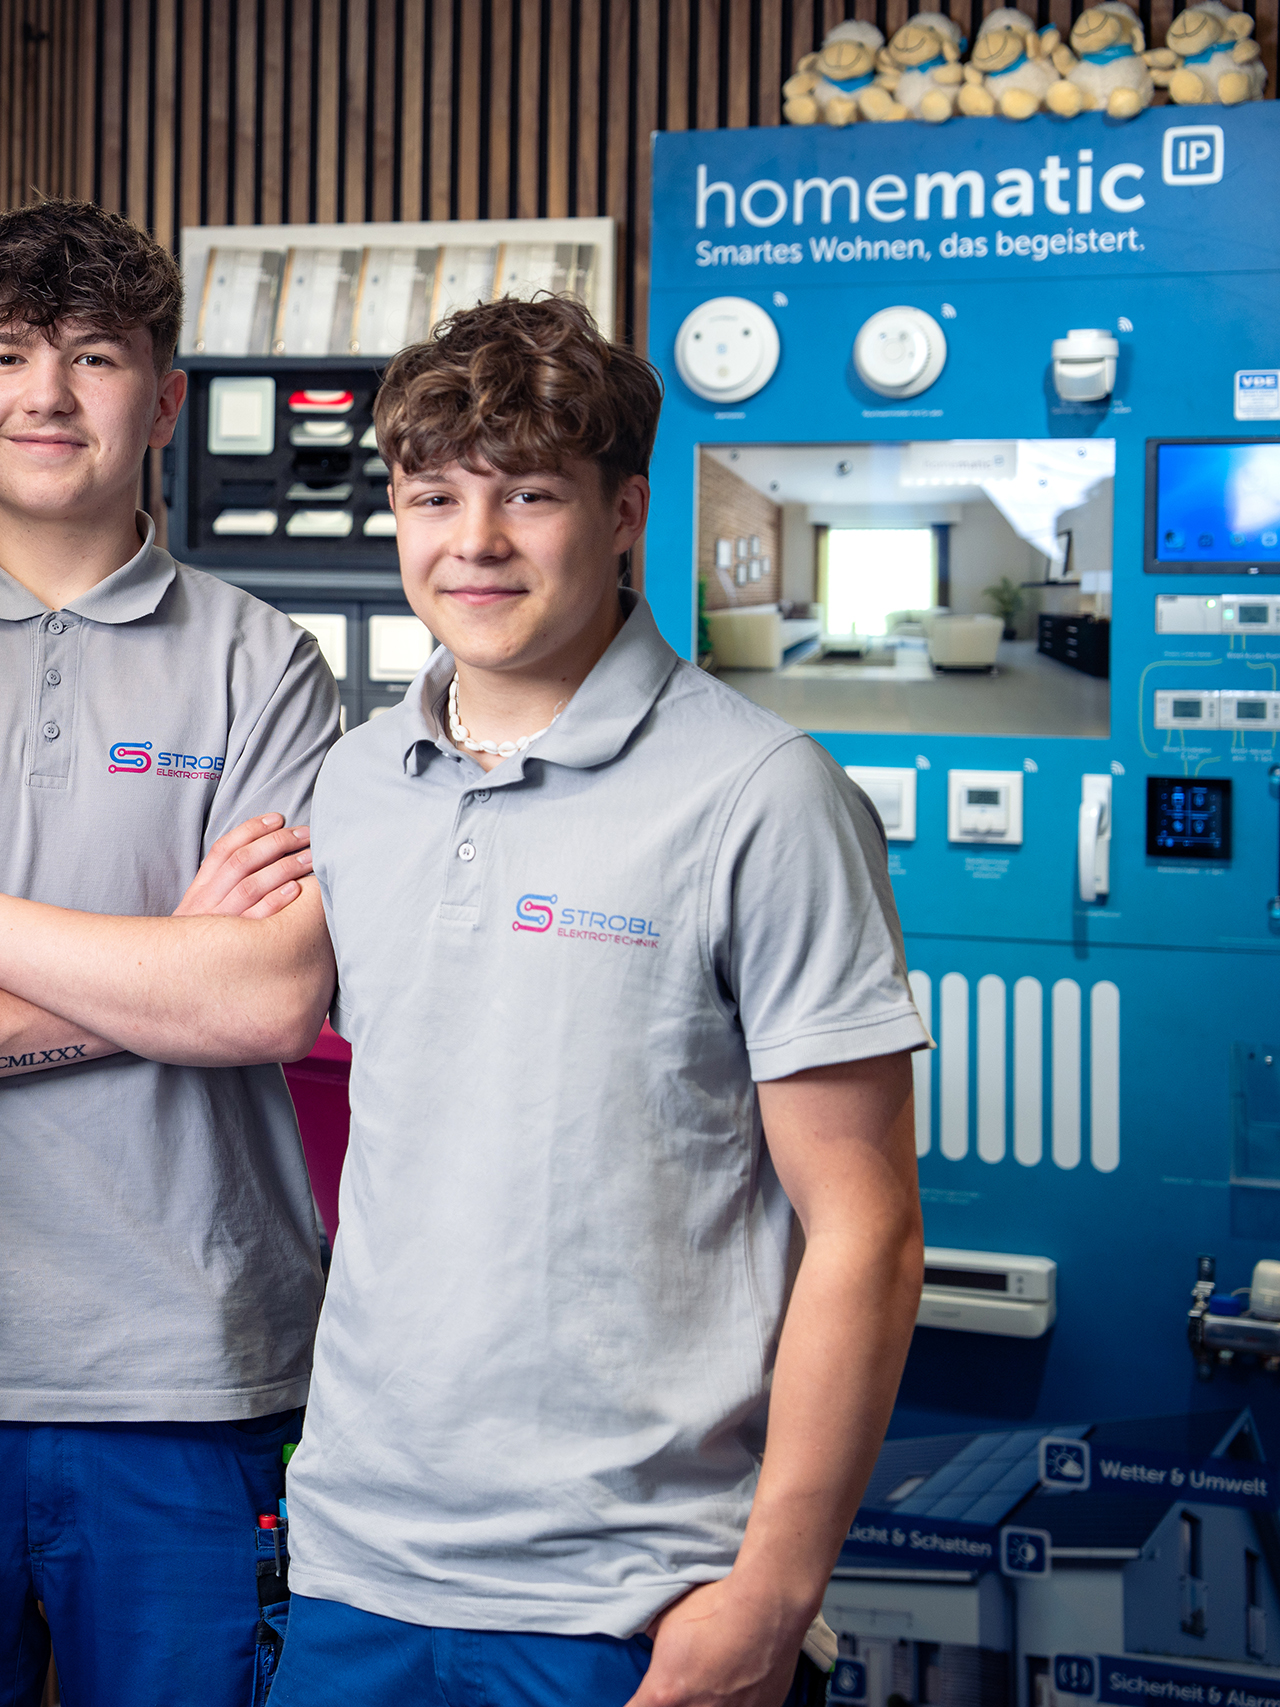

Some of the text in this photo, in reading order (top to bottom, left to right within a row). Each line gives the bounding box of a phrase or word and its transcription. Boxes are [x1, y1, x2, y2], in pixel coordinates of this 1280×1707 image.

[695, 140, 1211, 230] homematic IP
[695, 227, 1146, 267] Smartes Wohnen, das begeistert.
[1241, 376, 1276, 388] VDE
[157, 752, 226, 771] STROB
[557, 927, 659, 949] ELEKTROTECHNIK
[560, 908, 660, 937] STROBL
[1099, 1459, 1268, 1497] Wetter & Umwelt
[892, 1527, 906, 1547] &
[909, 1530, 992, 1558] Schatten
[1109, 1671, 1204, 1703] Sicherheit
